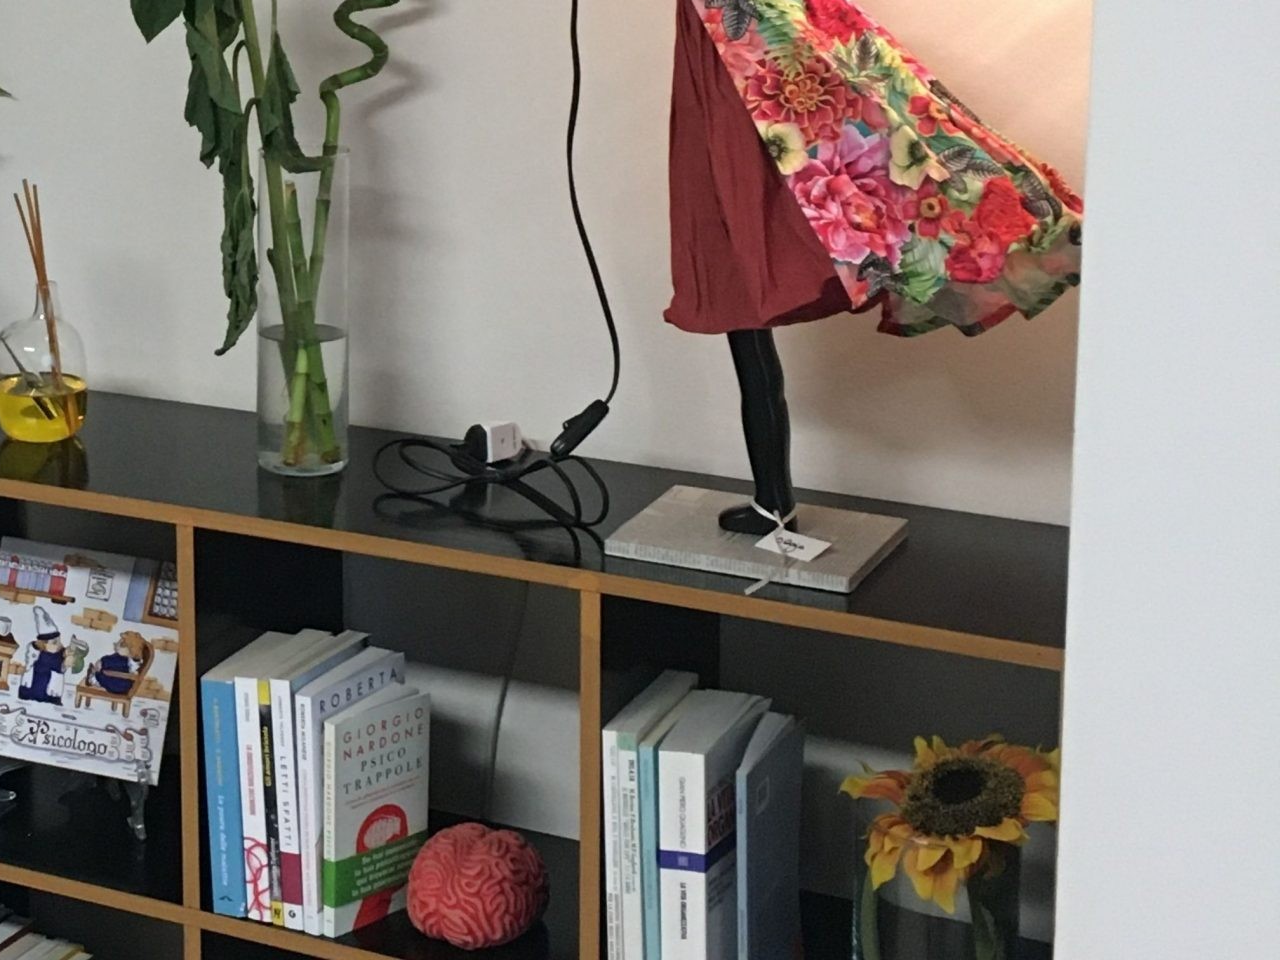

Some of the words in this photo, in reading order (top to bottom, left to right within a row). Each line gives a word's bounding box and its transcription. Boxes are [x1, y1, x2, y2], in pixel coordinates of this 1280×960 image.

[319, 666, 398, 715] ROBERTA
[23, 718, 108, 756] Psicologo
[342, 706, 425, 745] GIORGIO
[342, 723, 425, 762] NARDONE
[279, 755, 290, 794] LETTI
[342, 756, 425, 795] TRAPPOLE
[360, 747, 408, 773] PSICO
[217, 805, 227, 831] paura
[281, 800, 292, 848] SFATTI
[218, 832, 229, 852] delle
[219, 853, 231, 887] malattie
